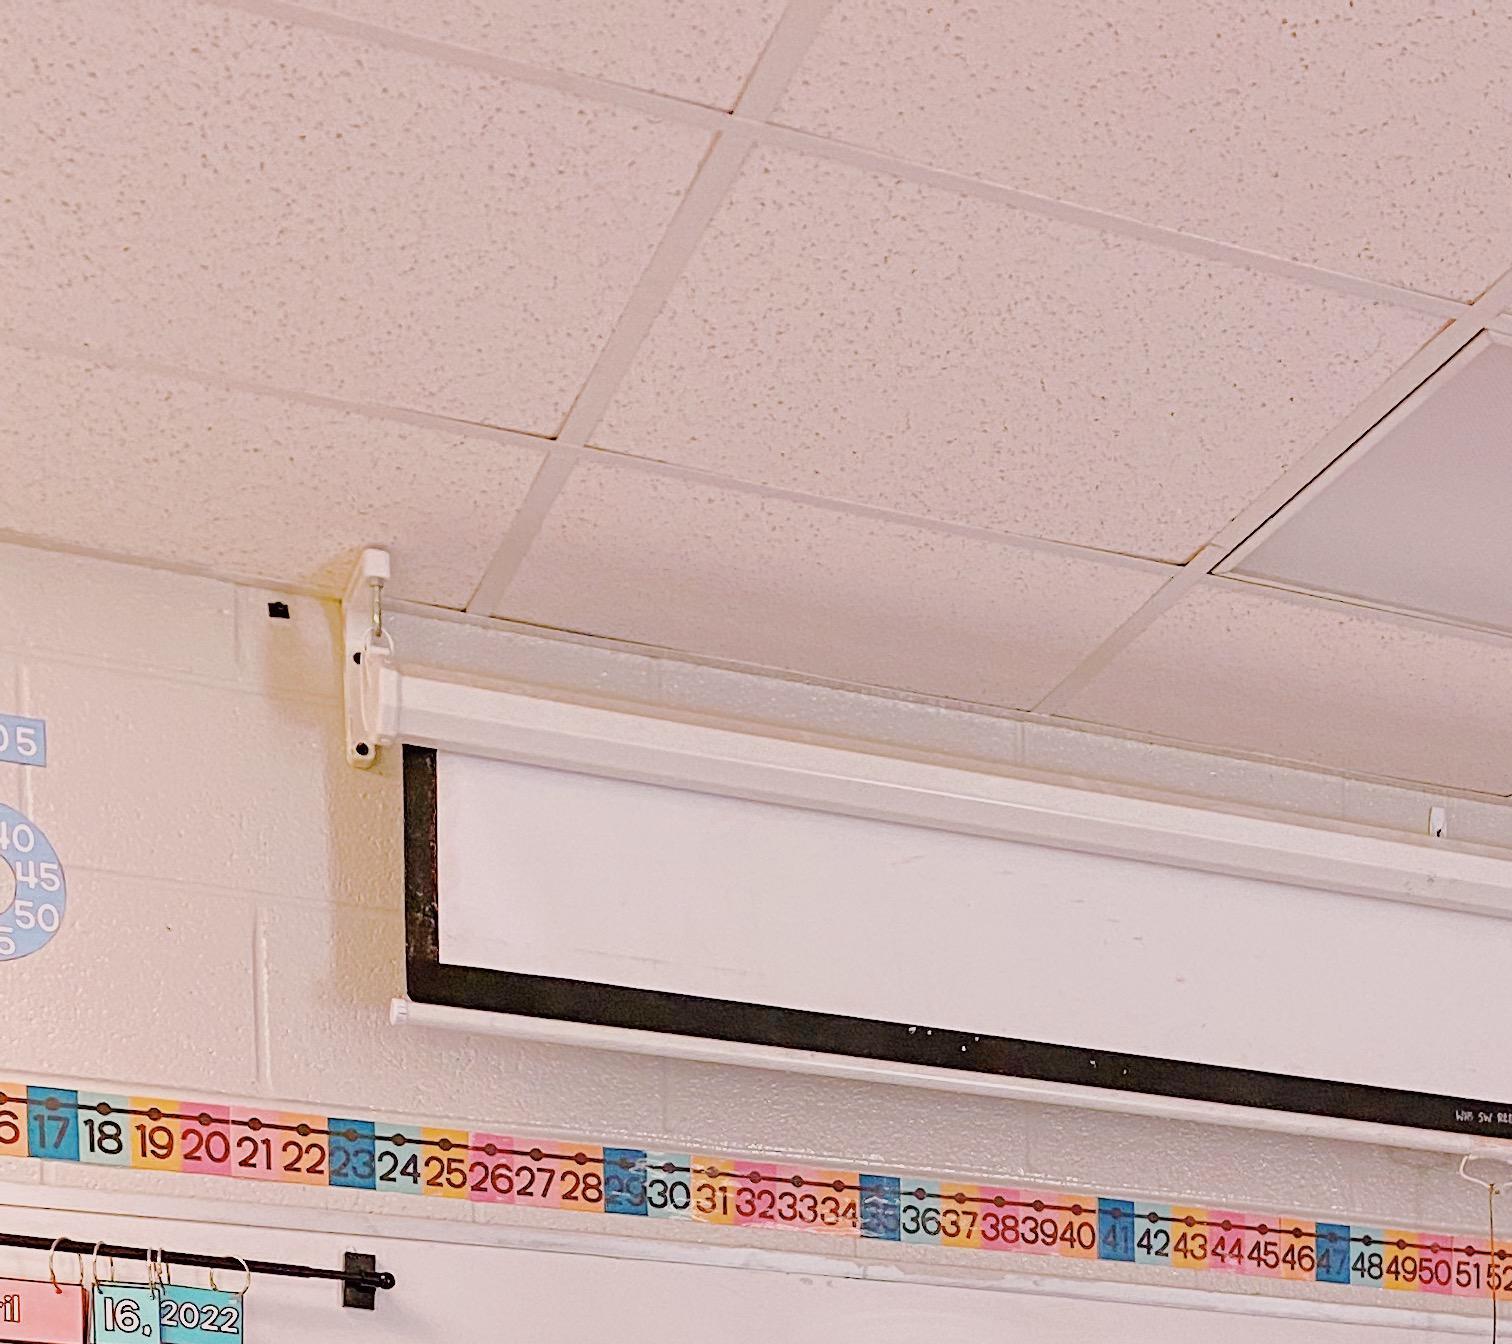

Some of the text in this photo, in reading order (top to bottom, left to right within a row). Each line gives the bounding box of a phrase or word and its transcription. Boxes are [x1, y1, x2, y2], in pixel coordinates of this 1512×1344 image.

[16, 861, 60, 891] 45
[15, 900, 60, 932] 50
[34, 1113, 69, 1149] 17
[83, 1119, 123, 1156] 18
[137, 1123, 173, 1158] 19
[180, 1129, 230, 1163] 20
[236, 1136, 272, 1170] 21
[282, 1141, 325, 1175] 22
[377, 1150, 420, 1185] 24
[424, 1156, 467, 1189] 25
[469, 1161, 514, 1194] 26
[516, 1166, 555, 1198] 27
[561, 1171, 602, 1203] 28
[647, 1179, 690, 1210] 30
[902, 1207, 940, 1236] 36
[982, 1214, 1020, 1244] 38
[1059, 1220, 1095, 1250] 40
[1137, 1228, 1169, 1257] 42
[1247, 1240, 1280, 1268] 45
[1351, 1252, 1383, 1280] 48
[160, 1300, 239, 1334] 2022
